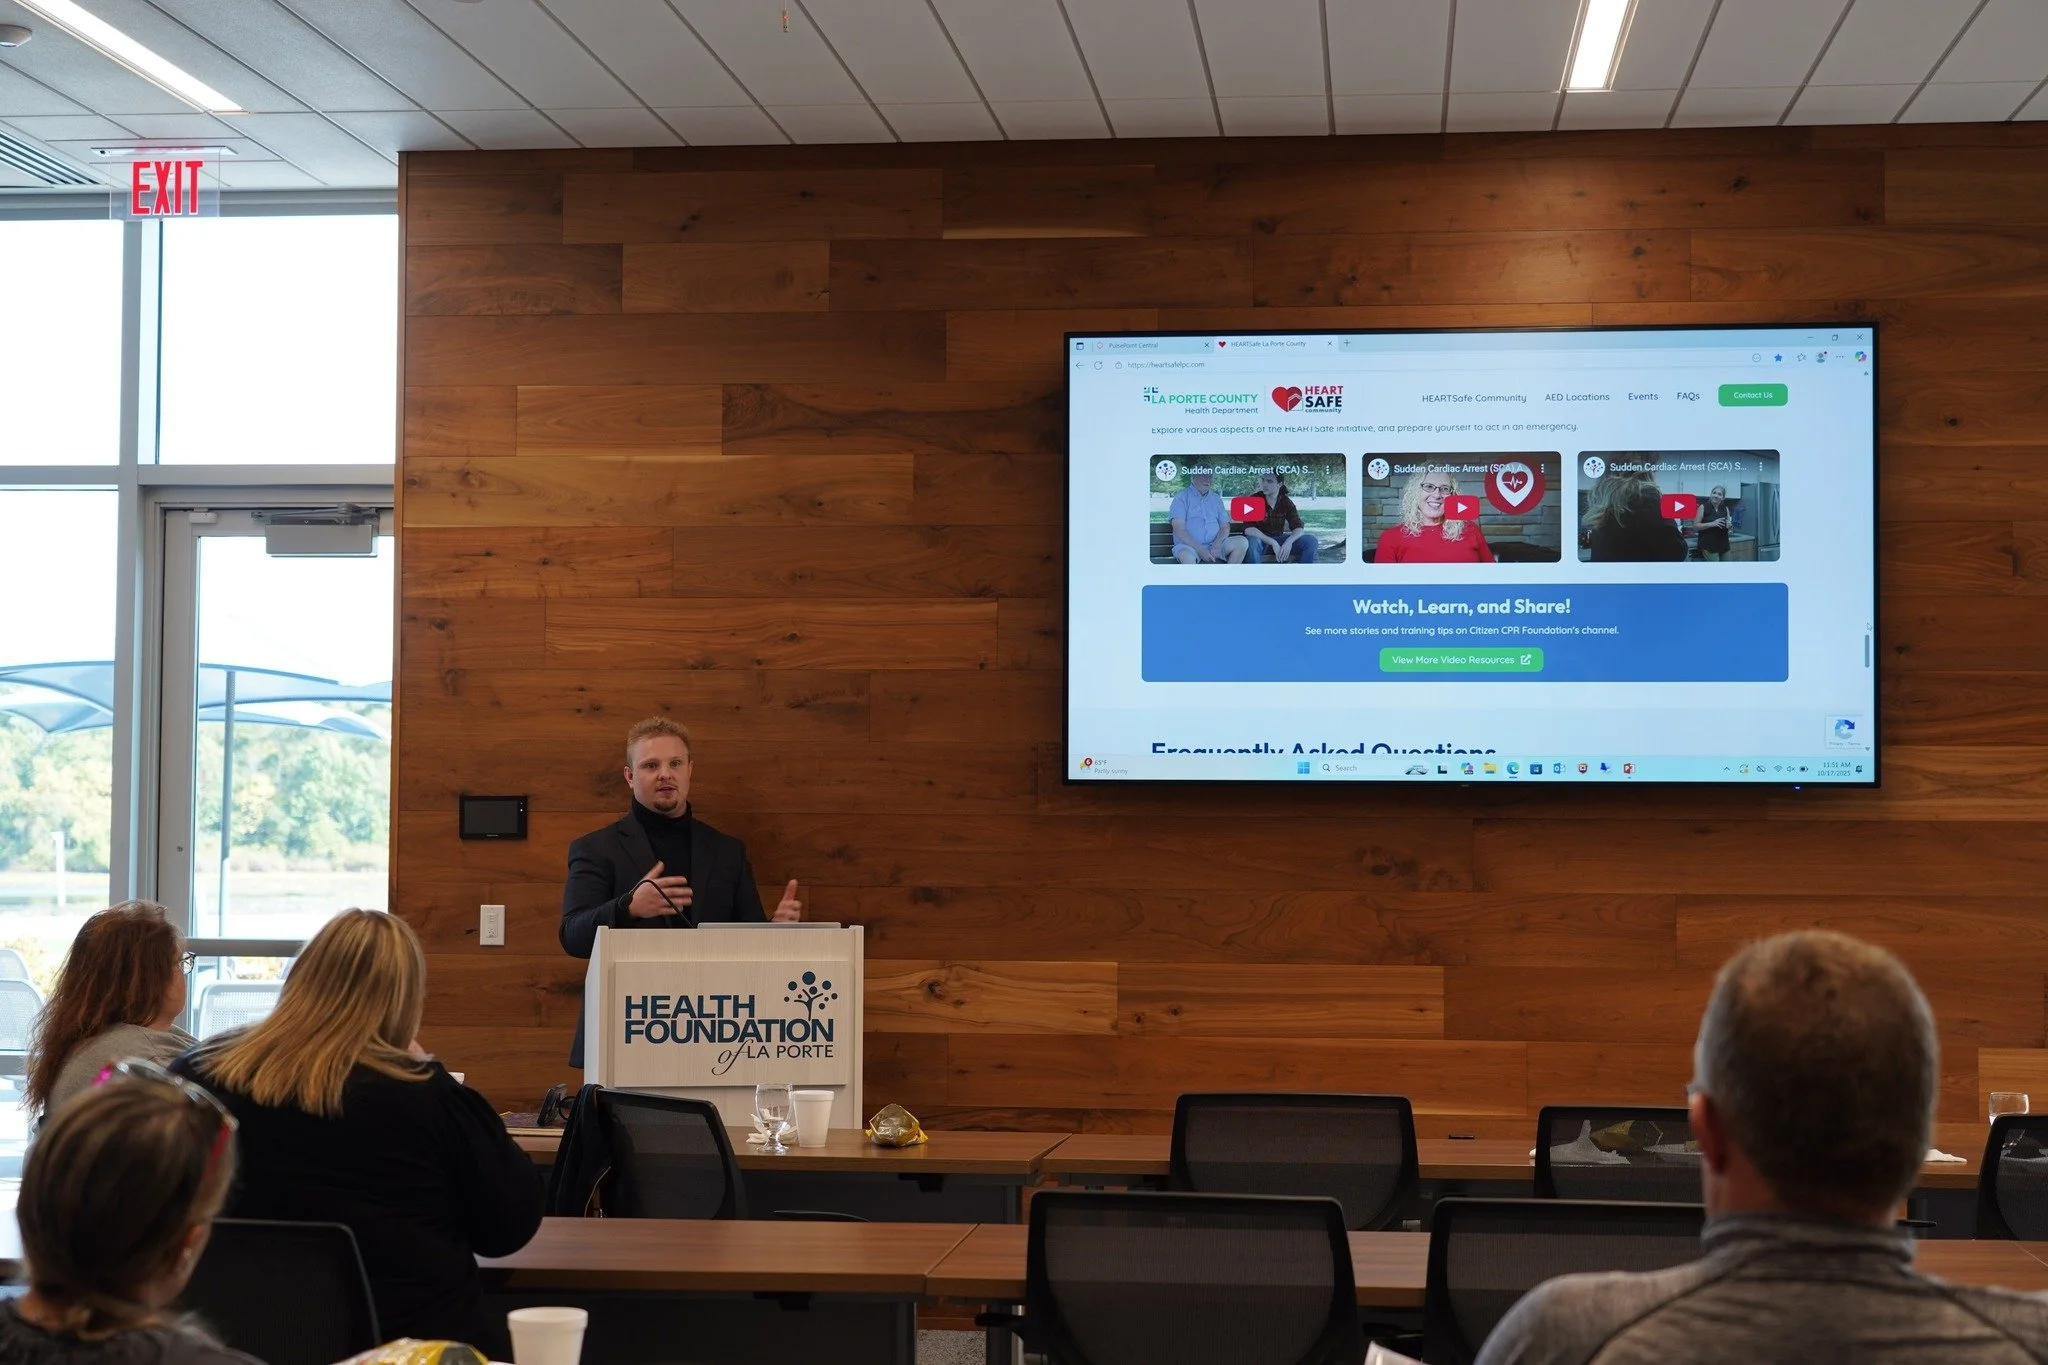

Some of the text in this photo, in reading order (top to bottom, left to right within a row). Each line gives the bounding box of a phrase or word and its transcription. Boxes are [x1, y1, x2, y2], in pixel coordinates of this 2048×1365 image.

[131, 160, 203, 216] EXIT
[1231, 340, 1261, 348] HEARTSafe
[1286, 339, 1306, 348] County
[1304, 385, 1344, 395] HEART
[1733, 391, 1773, 399] Contact Us
[1151, 394, 1259, 404] LA PORTE COUNTY
[1422, 393, 1527, 404] HEARTSafe Community
[1545, 392, 1610, 402] AED Locations
[1628, 392, 1659, 401] Events
[1676, 391, 1700, 402] FAQs
[1305, 396, 1342, 408] SAFE
[1185, 406, 1259, 415] Health Department
[1220, 427, 1254, 436] aspects
[1377, 424, 1395, 432] and
[1397, 425, 1433, 434] prepare
[1473, 424, 1483, 432] to
[1526, 423, 1579, 432] emergency.
[1181, 466, 1213, 475] Sudden
[1215, 465, 1247, 474] Cardiac
[1249, 465, 1274, 474] Arrest
[1276, 465, 1300, 475] (SCA)
[1394, 464, 1426, 474] Sudden
[1427, 464, 1460, 473] Cardiac
[1462, 464, 1488, 473] Arrest
[1490, 463, 1515, 473] (SCA)
[1610, 463, 1643, 472] Sudden
[1644, 462, 1678, 472] Cardiac
[1679, 462, 1706, 471] Arrest
[1708, 462, 1733, 472] (SCA)
[1353, 598, 1571, 616] Watch, Learn, and Share!
[1305, 627, 1322, 635] See
[1350, 627, 1379, 635] stories
[1381, 627, 1399, 635] and
[1400, 627, 1435, 637] training
[1437, 627, 1454, 636] tips
[1469, 626, 1499, 635] Citizen
[1501, 627, 1520, 635] CPR
[1581, 626, 1620, 635] channel.
[1392, 656, 1515, 664] View More Video Resources
[1335, 764, 1358, 772] Search
[625, 994, 755, 1019] HEALTH
[625, 1018, 834, 1044] FOUNDATION
[711, 1038, 834, 1076] of LA PORTE
